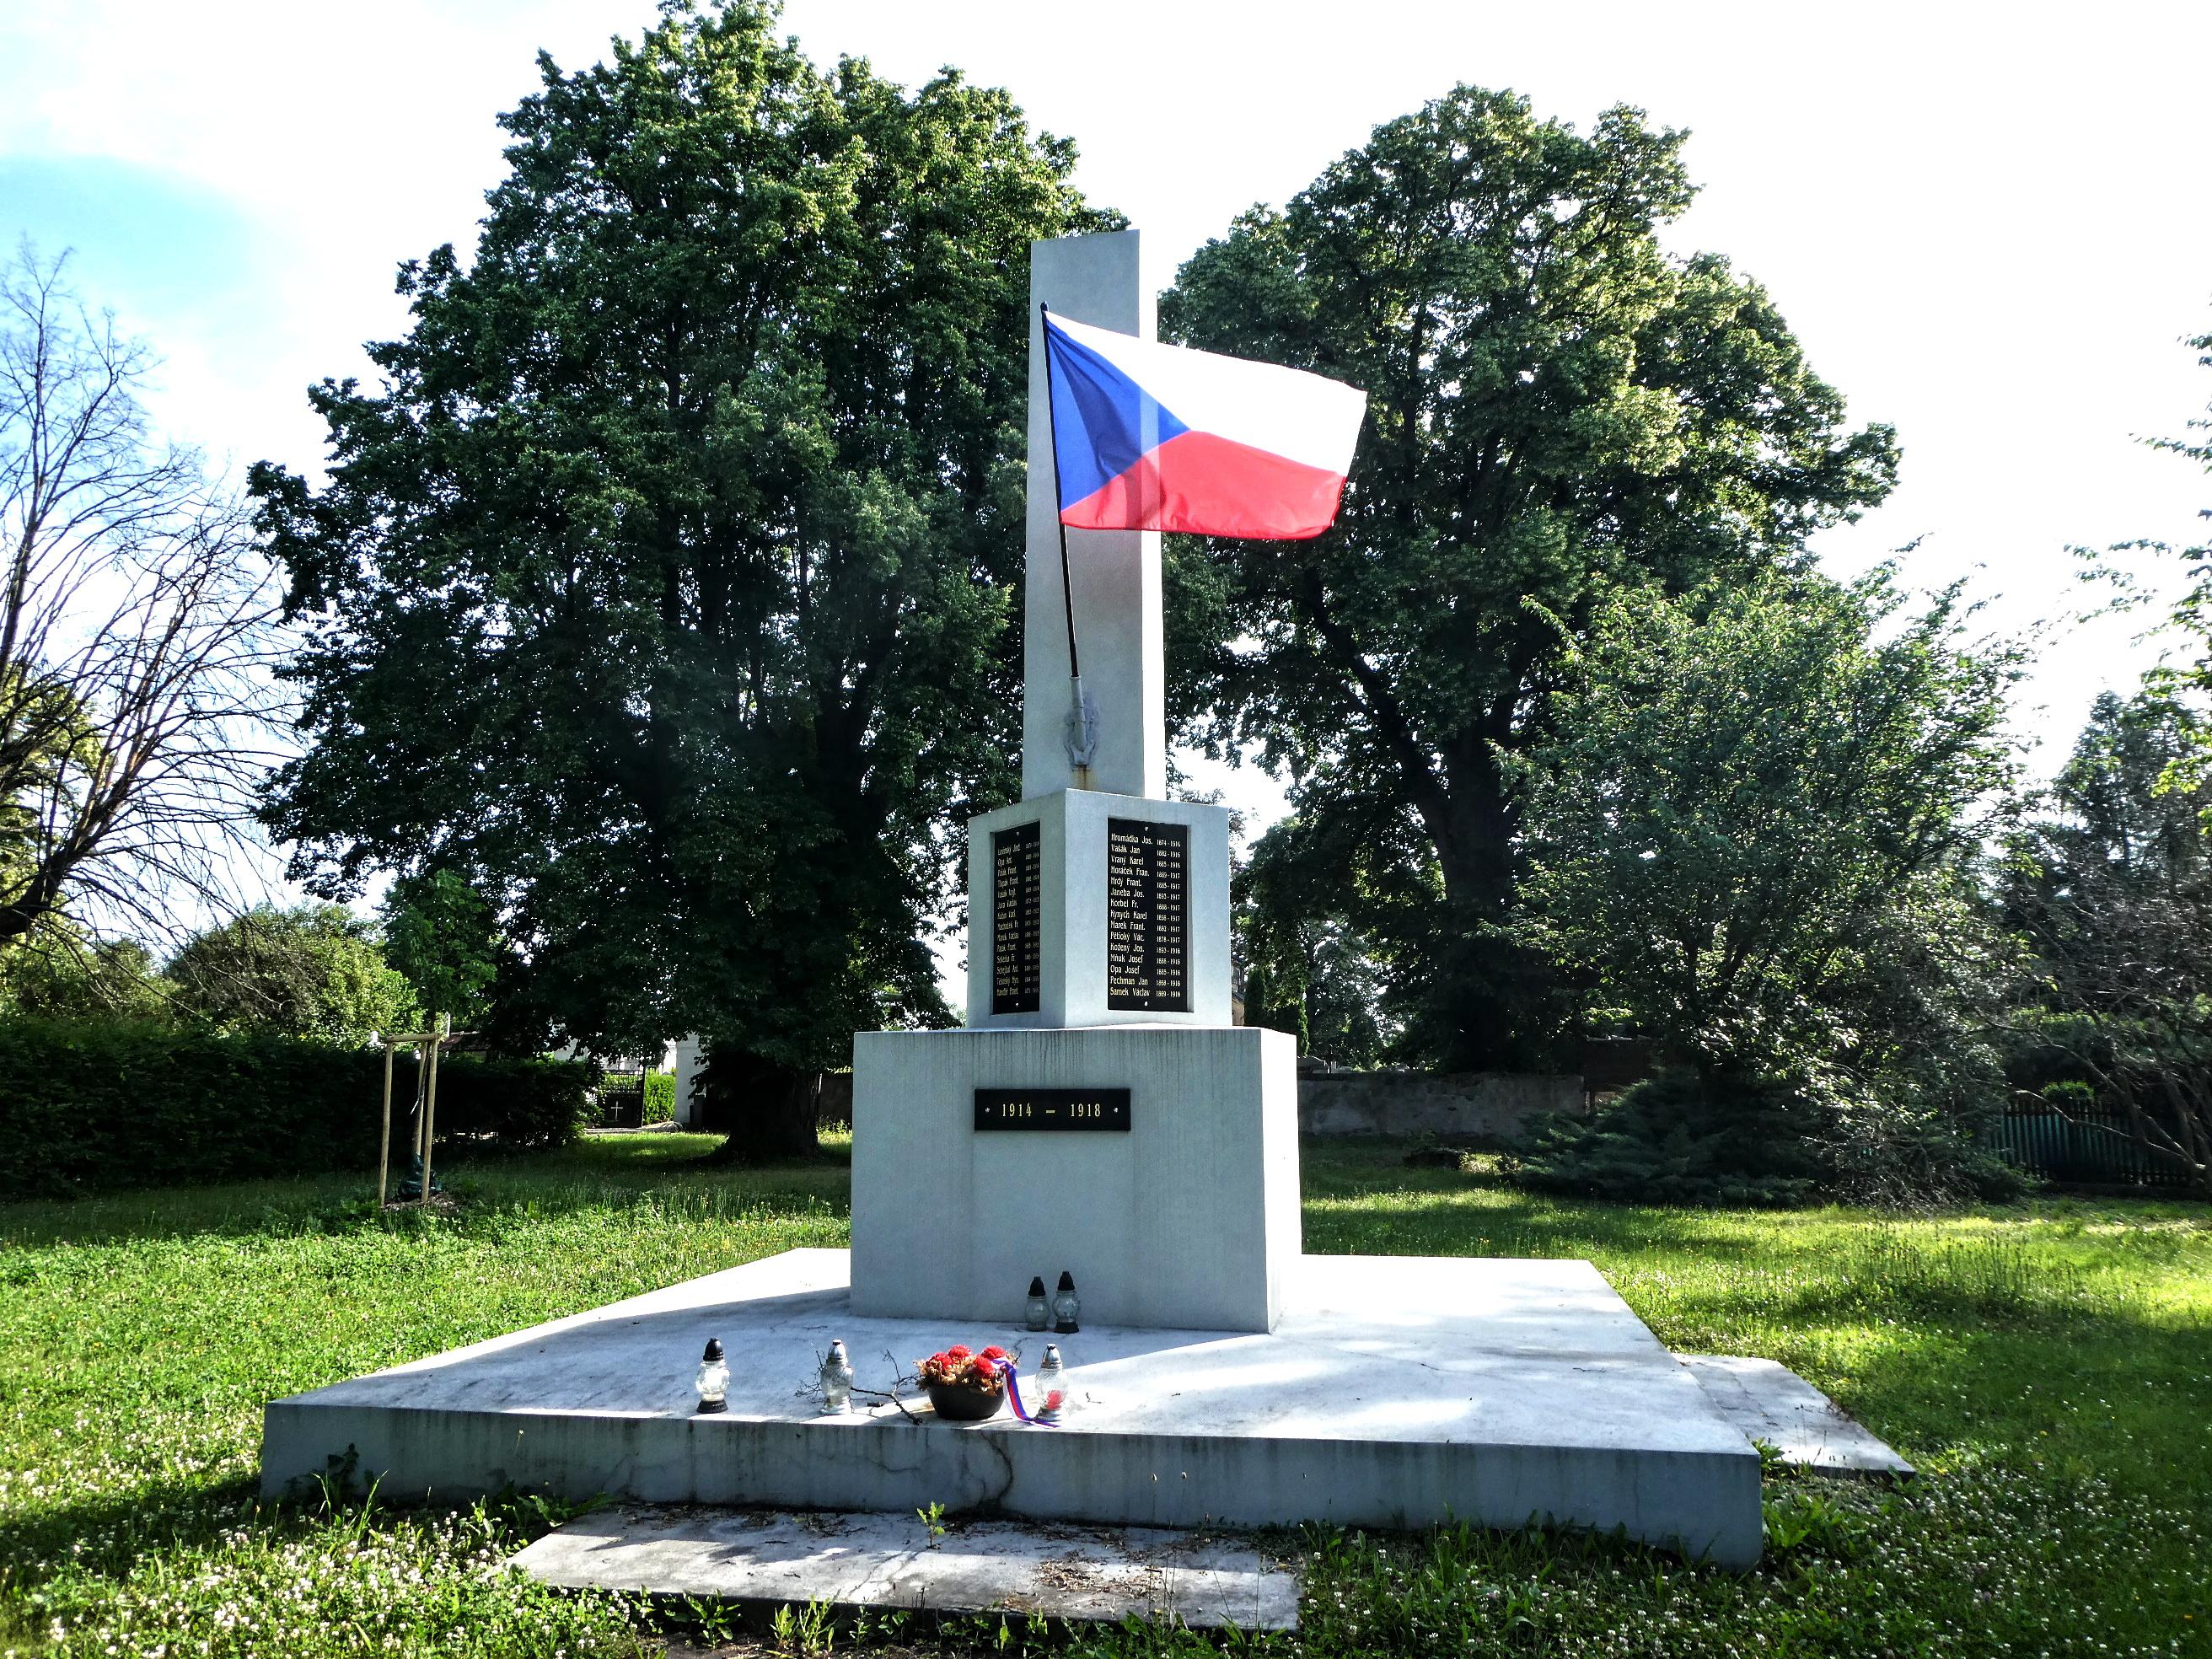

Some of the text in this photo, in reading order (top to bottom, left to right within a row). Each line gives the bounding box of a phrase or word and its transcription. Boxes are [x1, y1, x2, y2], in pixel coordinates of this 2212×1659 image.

[1112, 833, 1138, 843] Hromádka
[1130, 856, 1143, 865] Karel
[1111, 866, 1133, 875] Horáček
[1111, 877, 1123, 887] Hrdý
[1111, 888, 1130, 896] Janeba
[1111, 899, 1128, 908] Korbel
[1111, 921, 1126, 929] Marek
[1111, 943, 1130, 953] Kožený
[1110, 965, 1121, 974] Opa
[1110, 976, 1135, 985] Pechman
[1110, 987, 1129, 996] Samek
[1002, 1103, 1032, 1117] 1914
[1071, 1103, 1100, 1117] 1918
